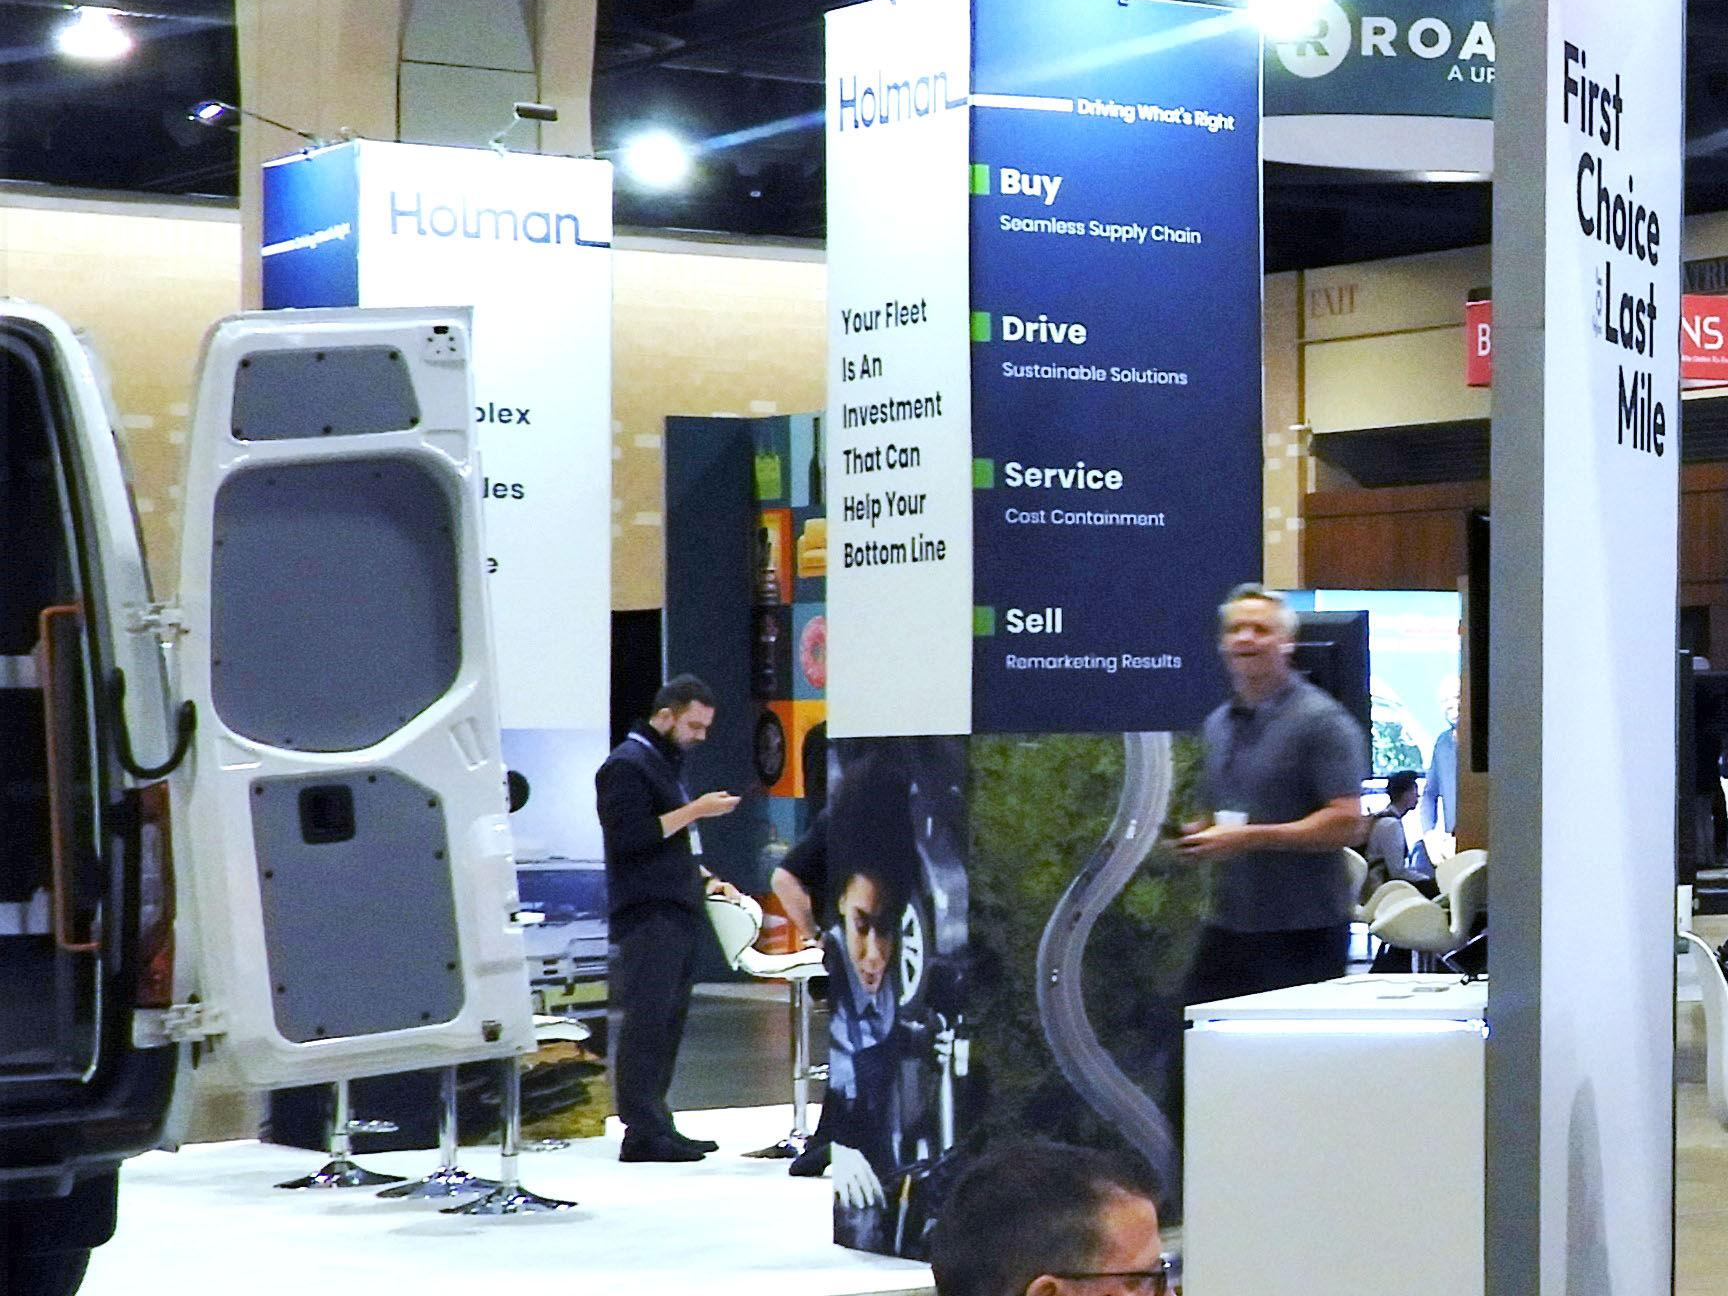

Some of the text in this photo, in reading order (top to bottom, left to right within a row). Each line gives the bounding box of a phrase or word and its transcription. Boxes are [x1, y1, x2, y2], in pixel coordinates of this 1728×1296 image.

[1361, 16, 1495, 63] ROA
[1447, 64, 1495, 84] A UP
[839, 70, 969, 132] Holman
[1562, 40, 1624, 152] First
[1076, 98, 1236, 134] Driving What's Right
[1001, 167, 1063, 205] Buy
[389, 190, 611, 248] Holman
[1576, 151, 1660, 266] Choice
[1000, 214, 1203, 245] Seamless Supply Chain
[841, 298, 928, 335] Your Fleet
[1605, 260, 1657, 359] Last
[1001, 314, 1088, 345] Drive
[842, 353, 883, 383] Is An
[1002, 361, 1188, 386] Sustainable Solutions
[843, 390, 943, 430] Investment
[1617, 363, 1666, 458] Mile
[842, 443, 921, 476] That Can
[1004, 460, 1124, 490] Service
[843, 490, 928, 528] Help Your
[1005, 508, 1166, 527] Cost Containment
[844, 532, 947, 569] Bottom Line
[1006, 606, 1063, 634] Sell
[1005, 653, 1183, 674] Remarketing Results
